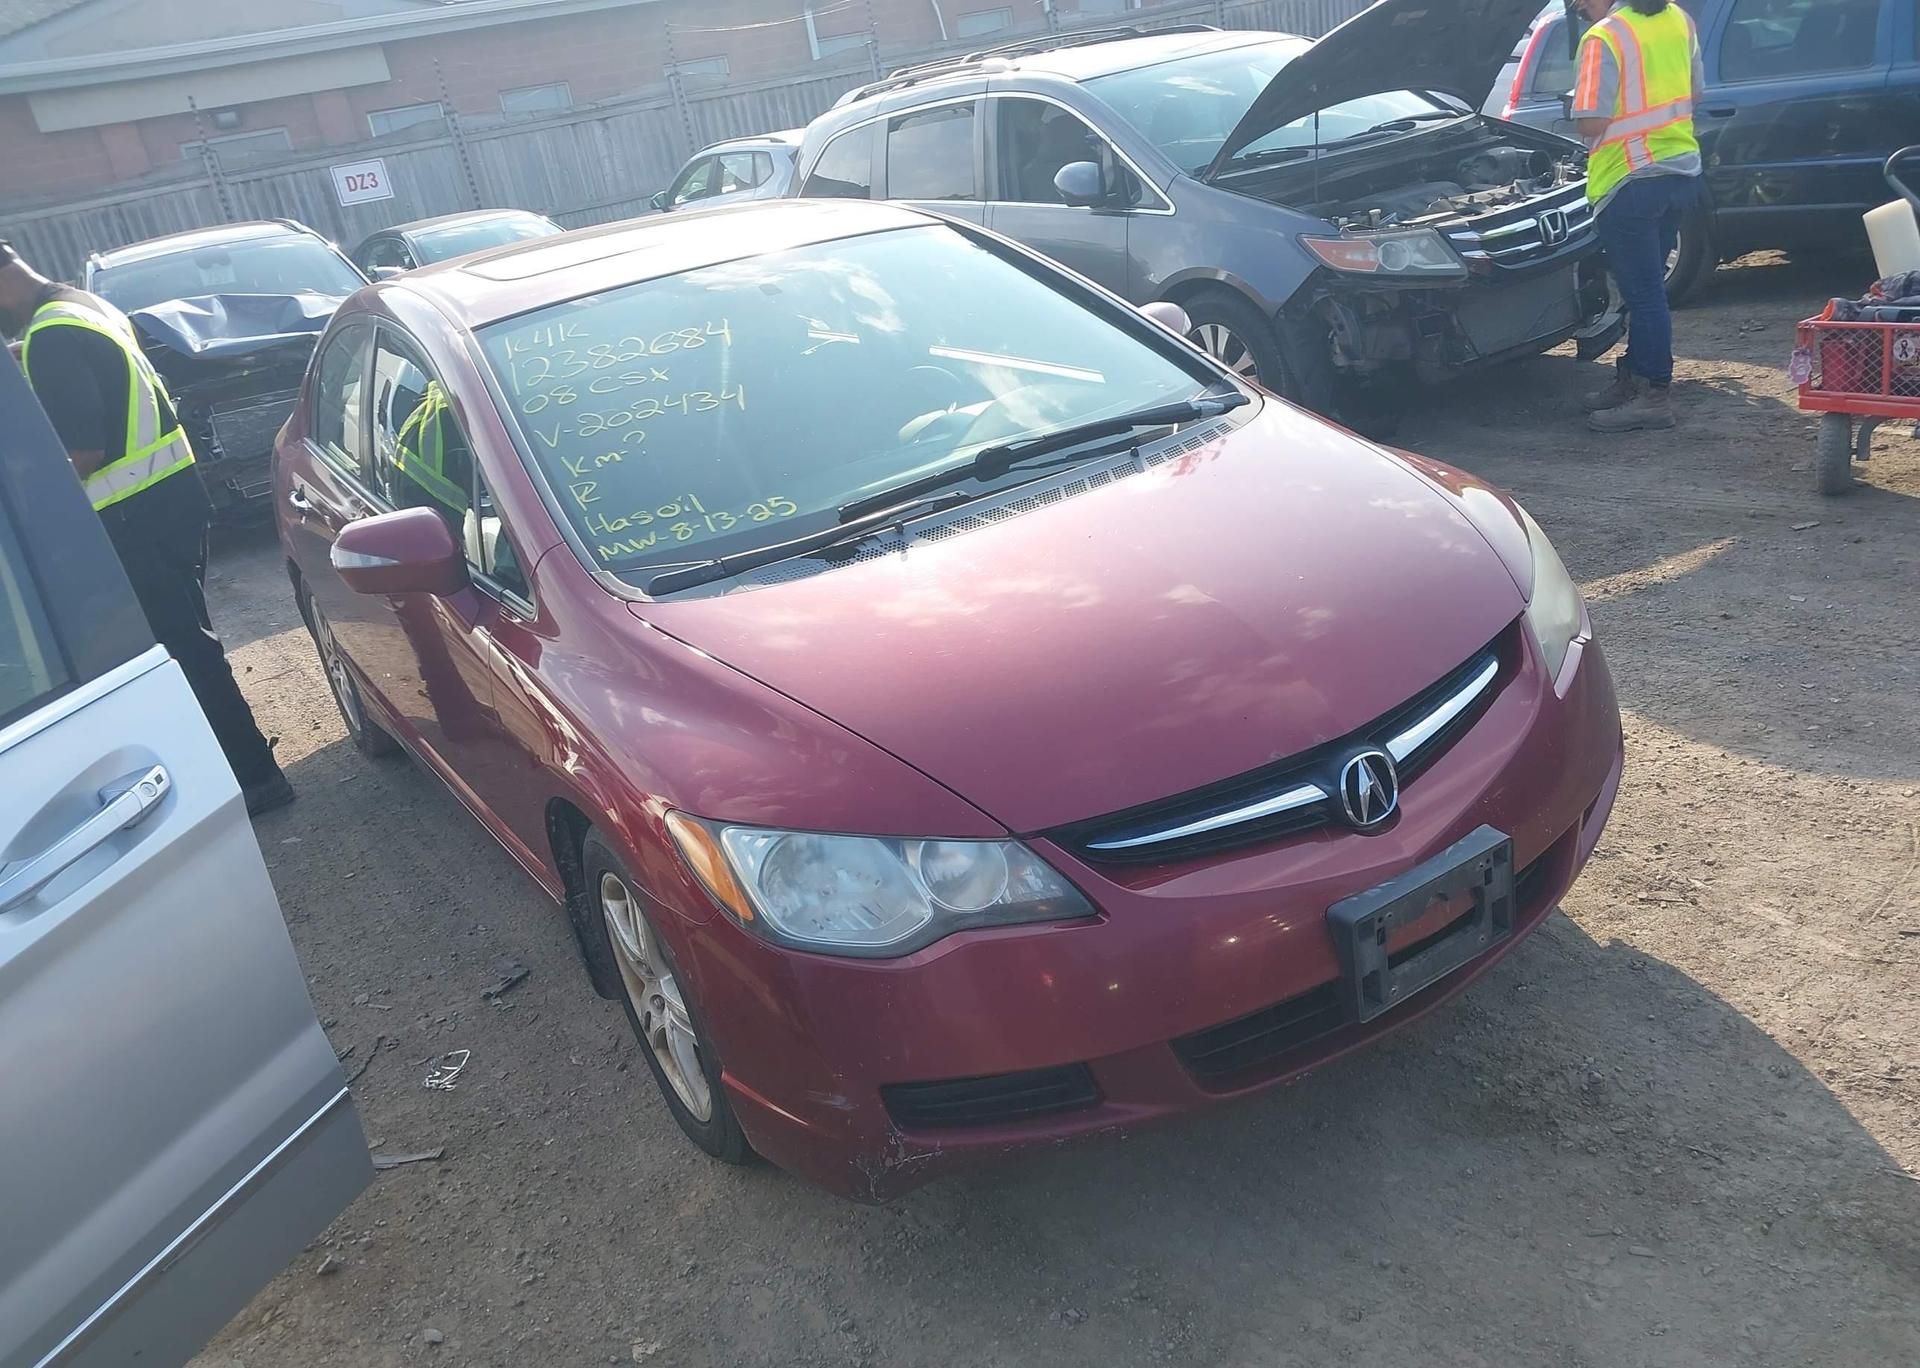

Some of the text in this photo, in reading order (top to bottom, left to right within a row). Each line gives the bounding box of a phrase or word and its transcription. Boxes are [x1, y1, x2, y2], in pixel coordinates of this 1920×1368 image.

[345, 172, 379, 192] DZ3
[510, 317, 732, 396] 12382684
[521, 384, 578, 414] 08
[533, 384, 745, 448] V-202434
